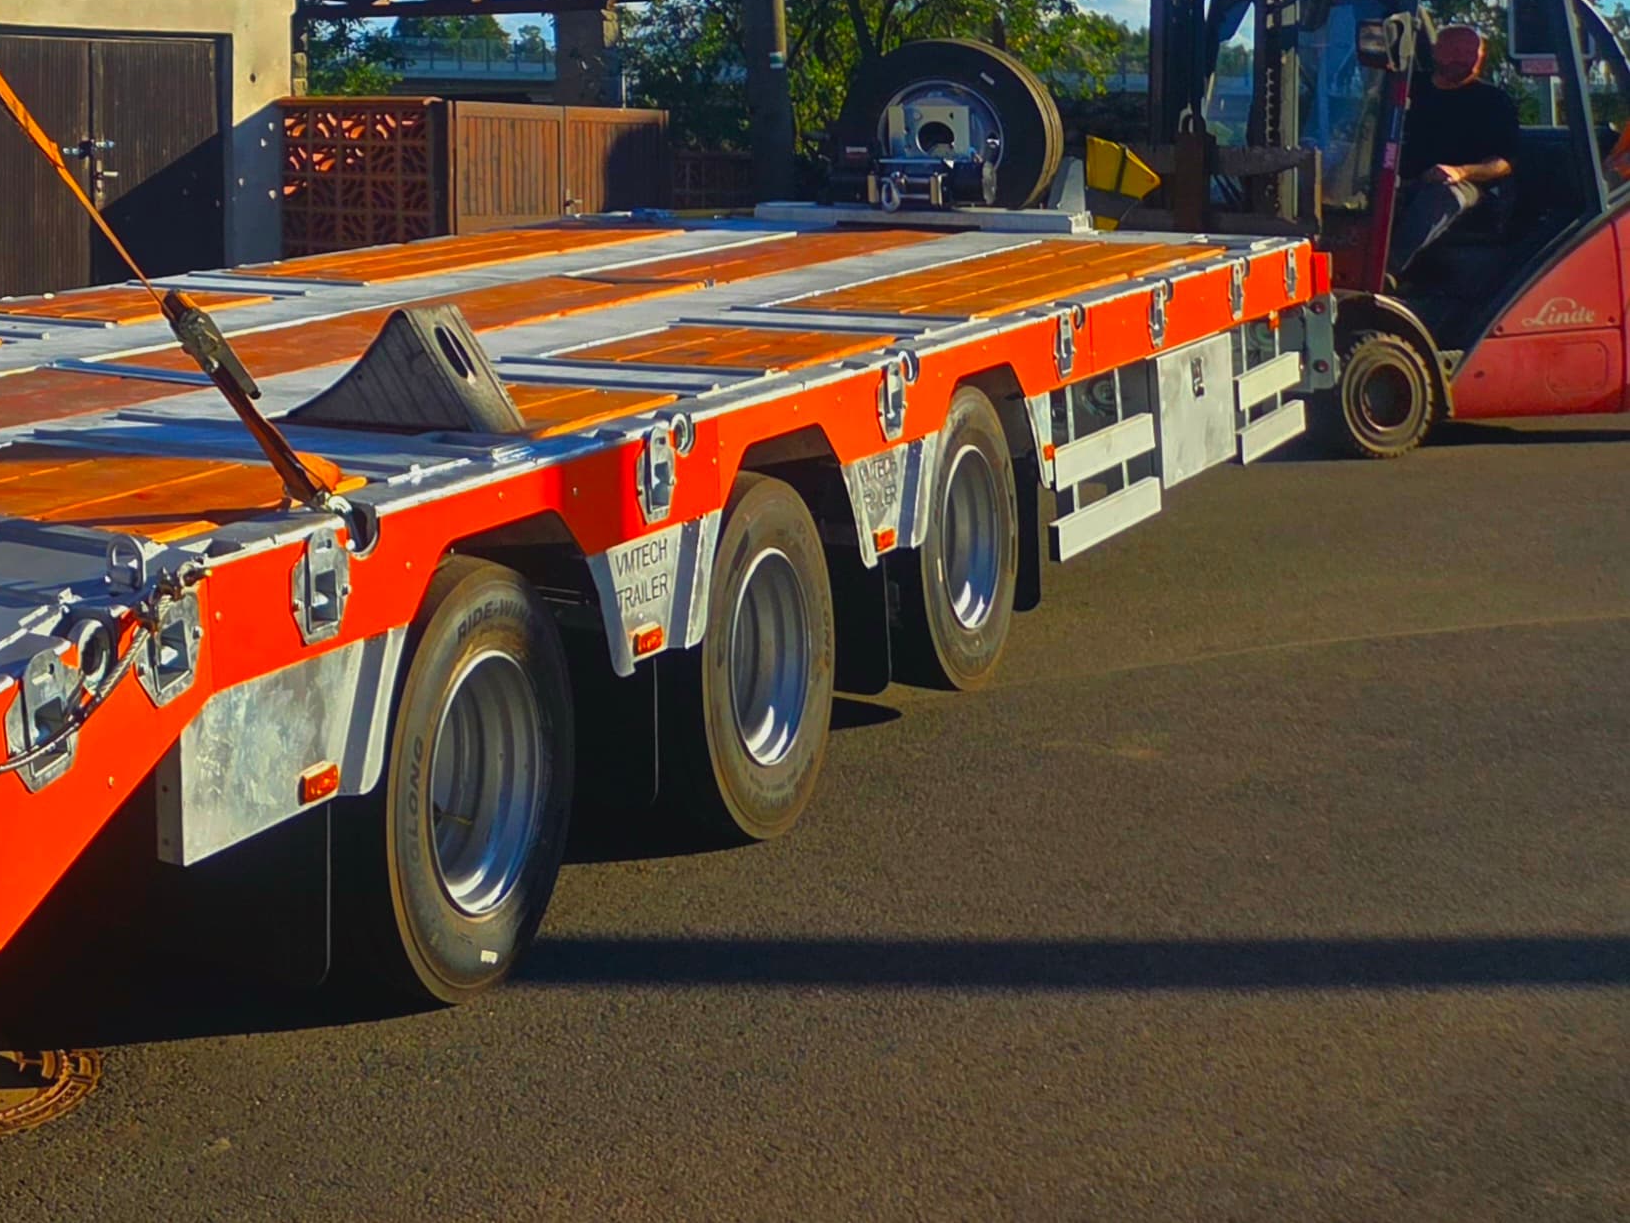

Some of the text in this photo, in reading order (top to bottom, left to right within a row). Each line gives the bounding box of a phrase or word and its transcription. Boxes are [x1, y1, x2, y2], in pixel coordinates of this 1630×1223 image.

[1522, 296, 1594, 327] Linde
[615, 538, 668, 577] VMTECH
[617, 573, 669, 612] TRAILER
